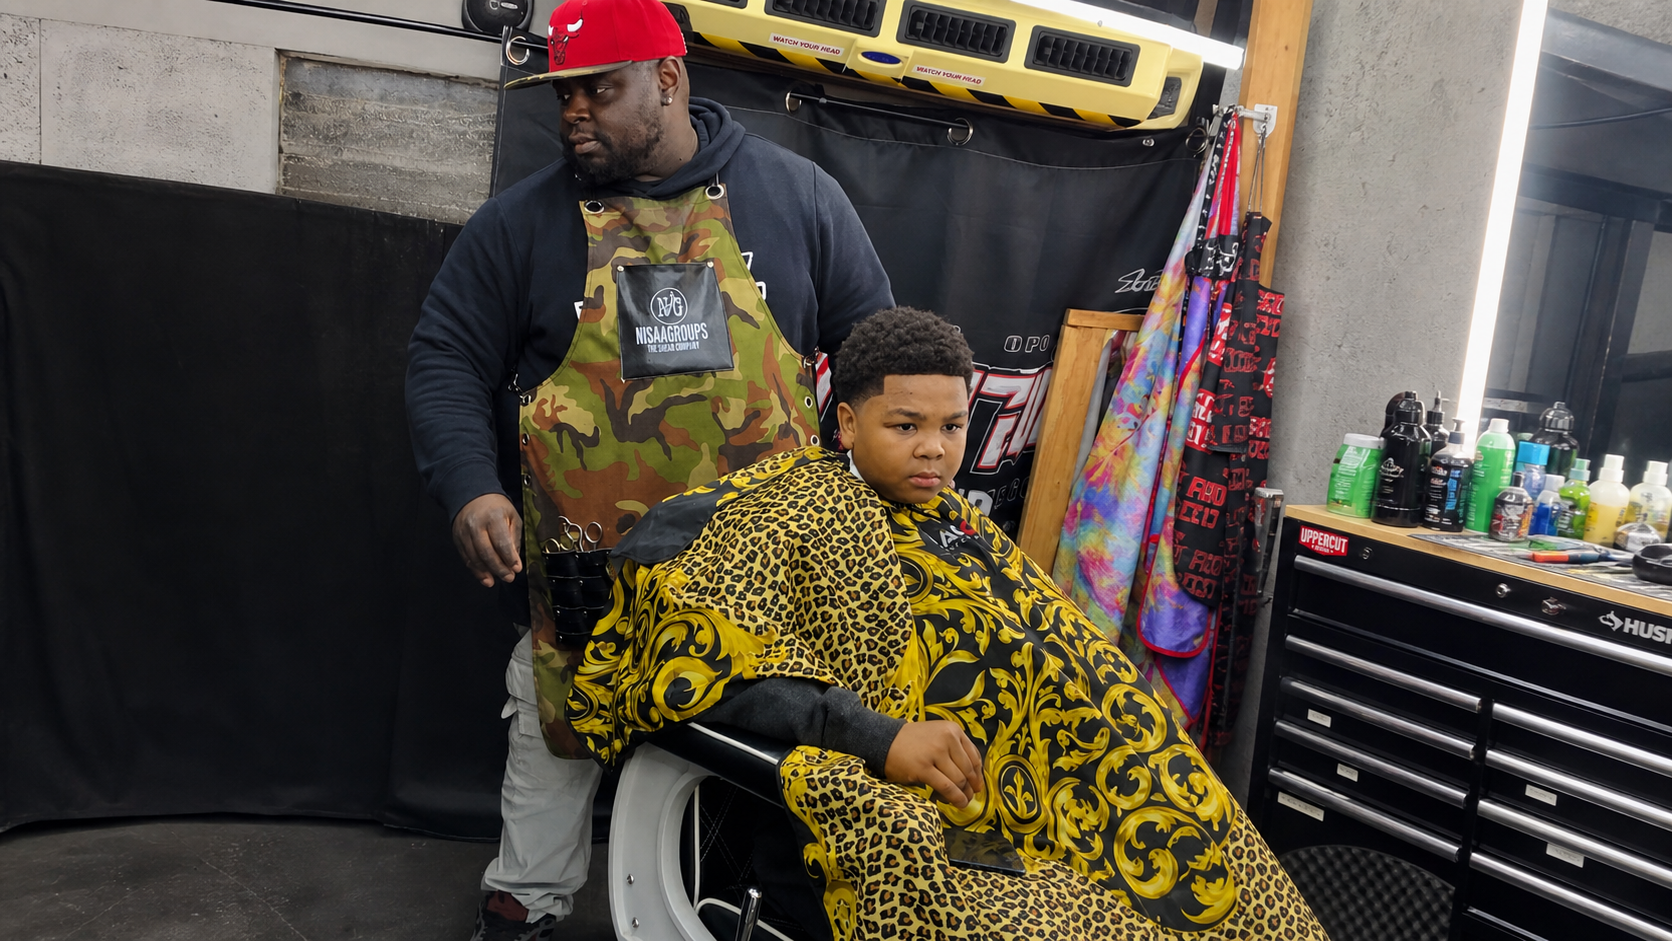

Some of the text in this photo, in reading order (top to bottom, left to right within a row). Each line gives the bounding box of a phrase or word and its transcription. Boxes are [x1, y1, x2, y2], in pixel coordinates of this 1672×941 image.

[773, 35, 841, 55] WATCH YOUR HEAD
[916, 66, 982, 85] WATCH YOUR HEAD
[635, 322, 709, 345] NISAAGROUPS
[647, 344, 658, 353] THE
[1300, 527, 1348, 554] UPPERCUT
